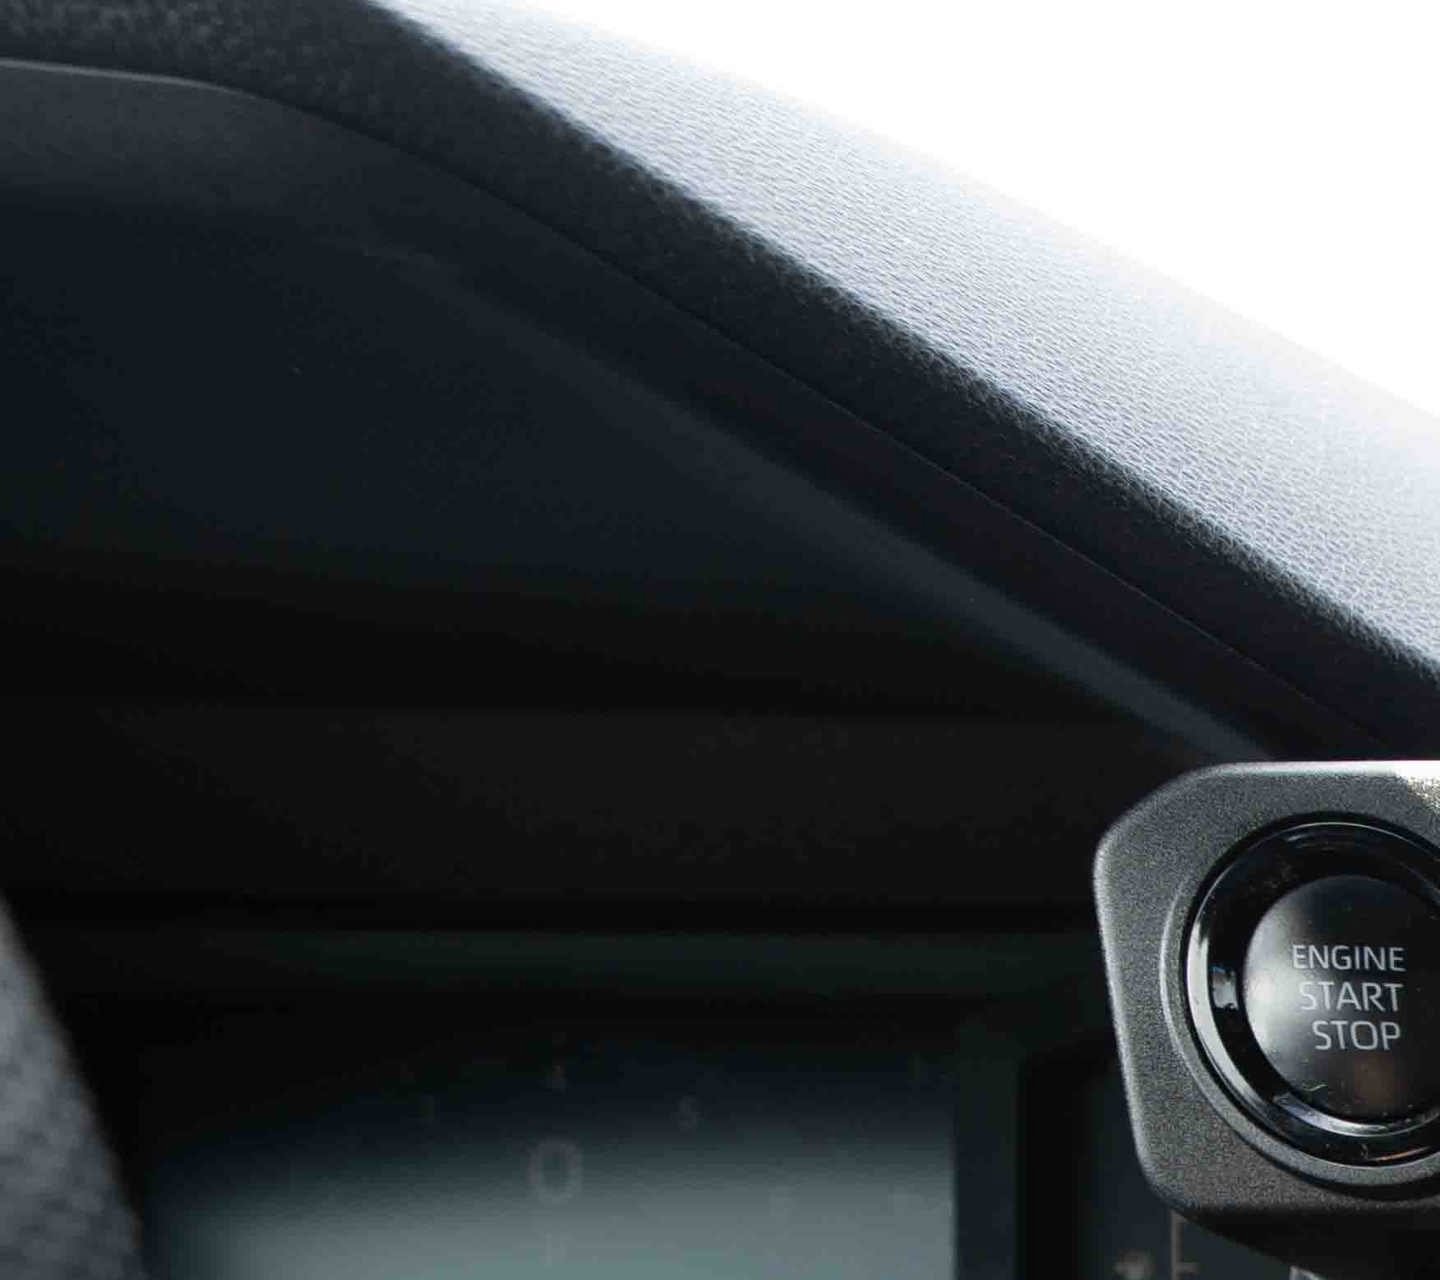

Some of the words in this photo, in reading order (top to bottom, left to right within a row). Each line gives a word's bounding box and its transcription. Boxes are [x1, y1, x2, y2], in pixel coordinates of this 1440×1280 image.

[1291, 943, 1406, 973] ENGINE
[1298, 980, 1403, 1013] START
[1311, 1019, 1402, 1052] STOP
